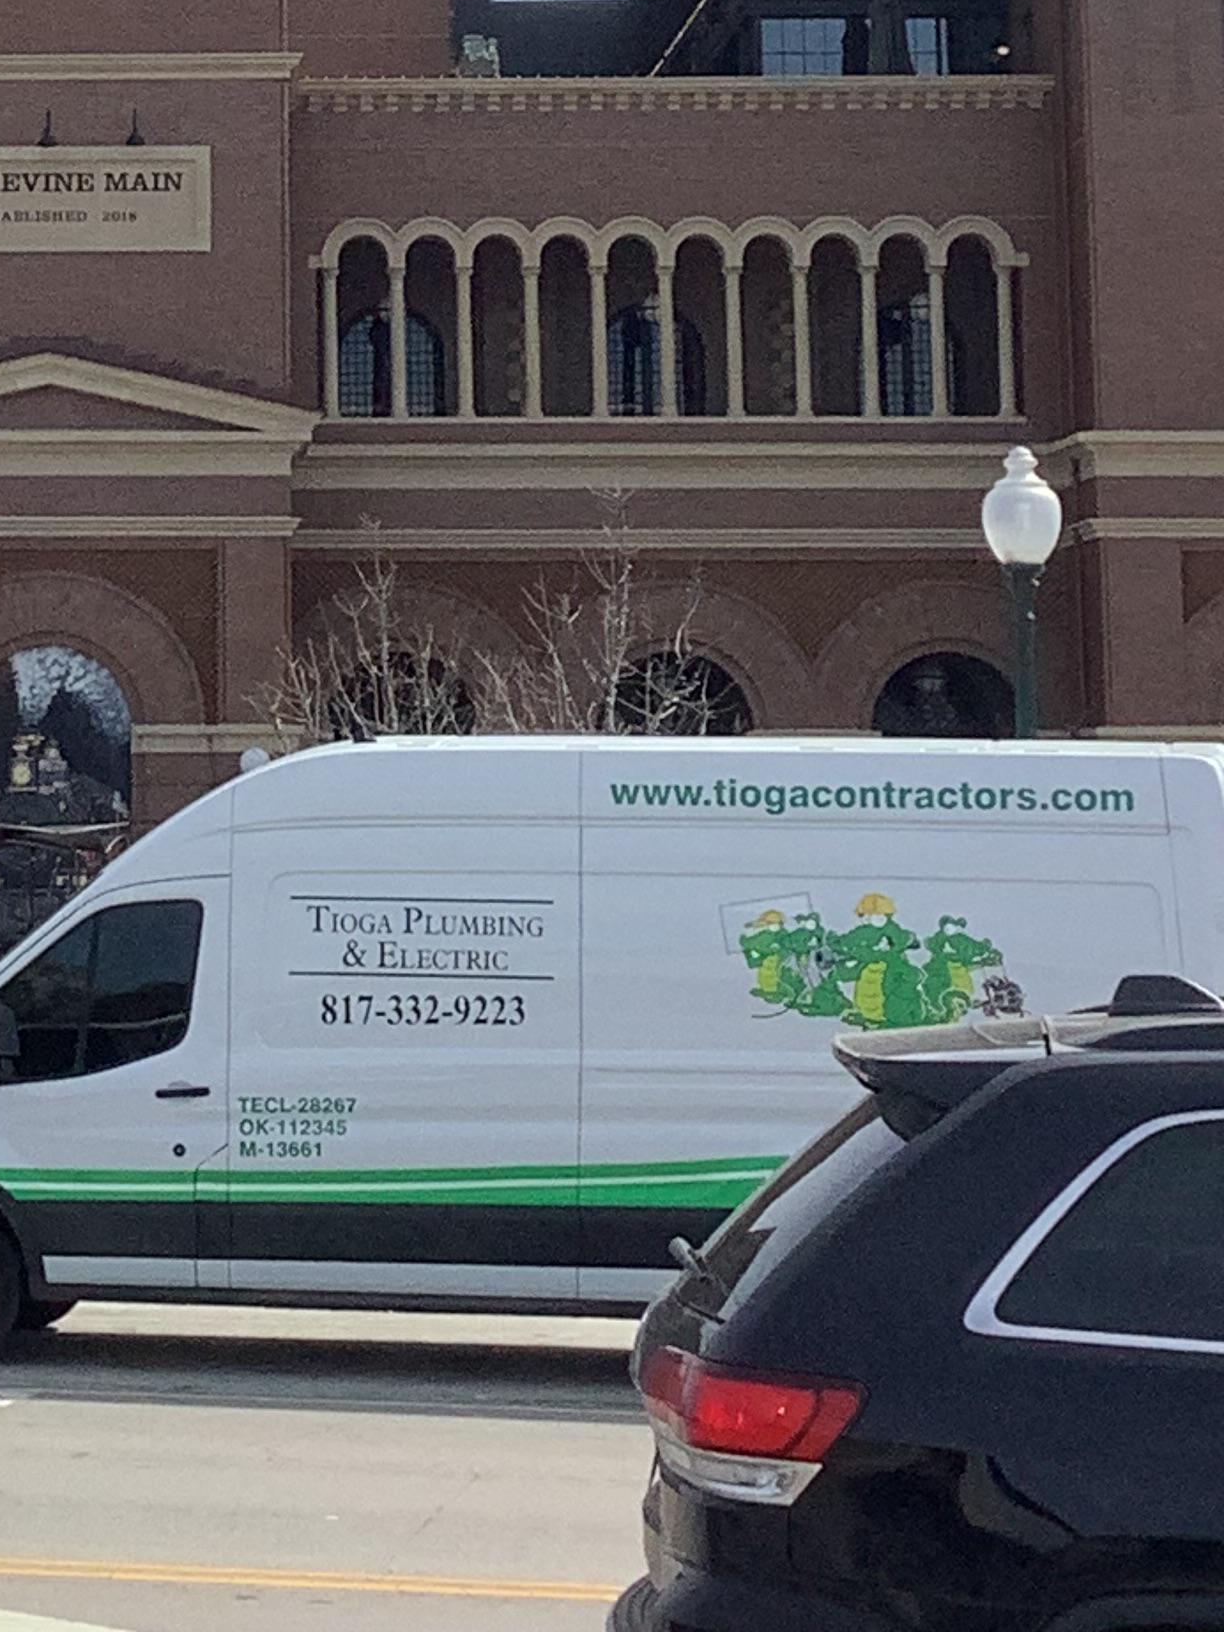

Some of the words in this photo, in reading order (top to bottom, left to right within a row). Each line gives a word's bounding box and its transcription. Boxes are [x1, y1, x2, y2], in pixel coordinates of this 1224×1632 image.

[104, 171, 184, 192] MAIN
[609, 778, 1135, 816] www.tiogacontractors.com
[306, 905, 392, 935] TIOGA
[402, 907, 545, 937] PLUMBING
[342, 940, 367, 968] &
[377, 941, 509, 971] ELECTRIC
[320, 994, 527, 1026] 817-332-9223
[238, 1096, 357, 1114] TECL-28267
[239, 1118, 348, 1136] OK-112345
[239, 1140, 323, 1158] M-13661
